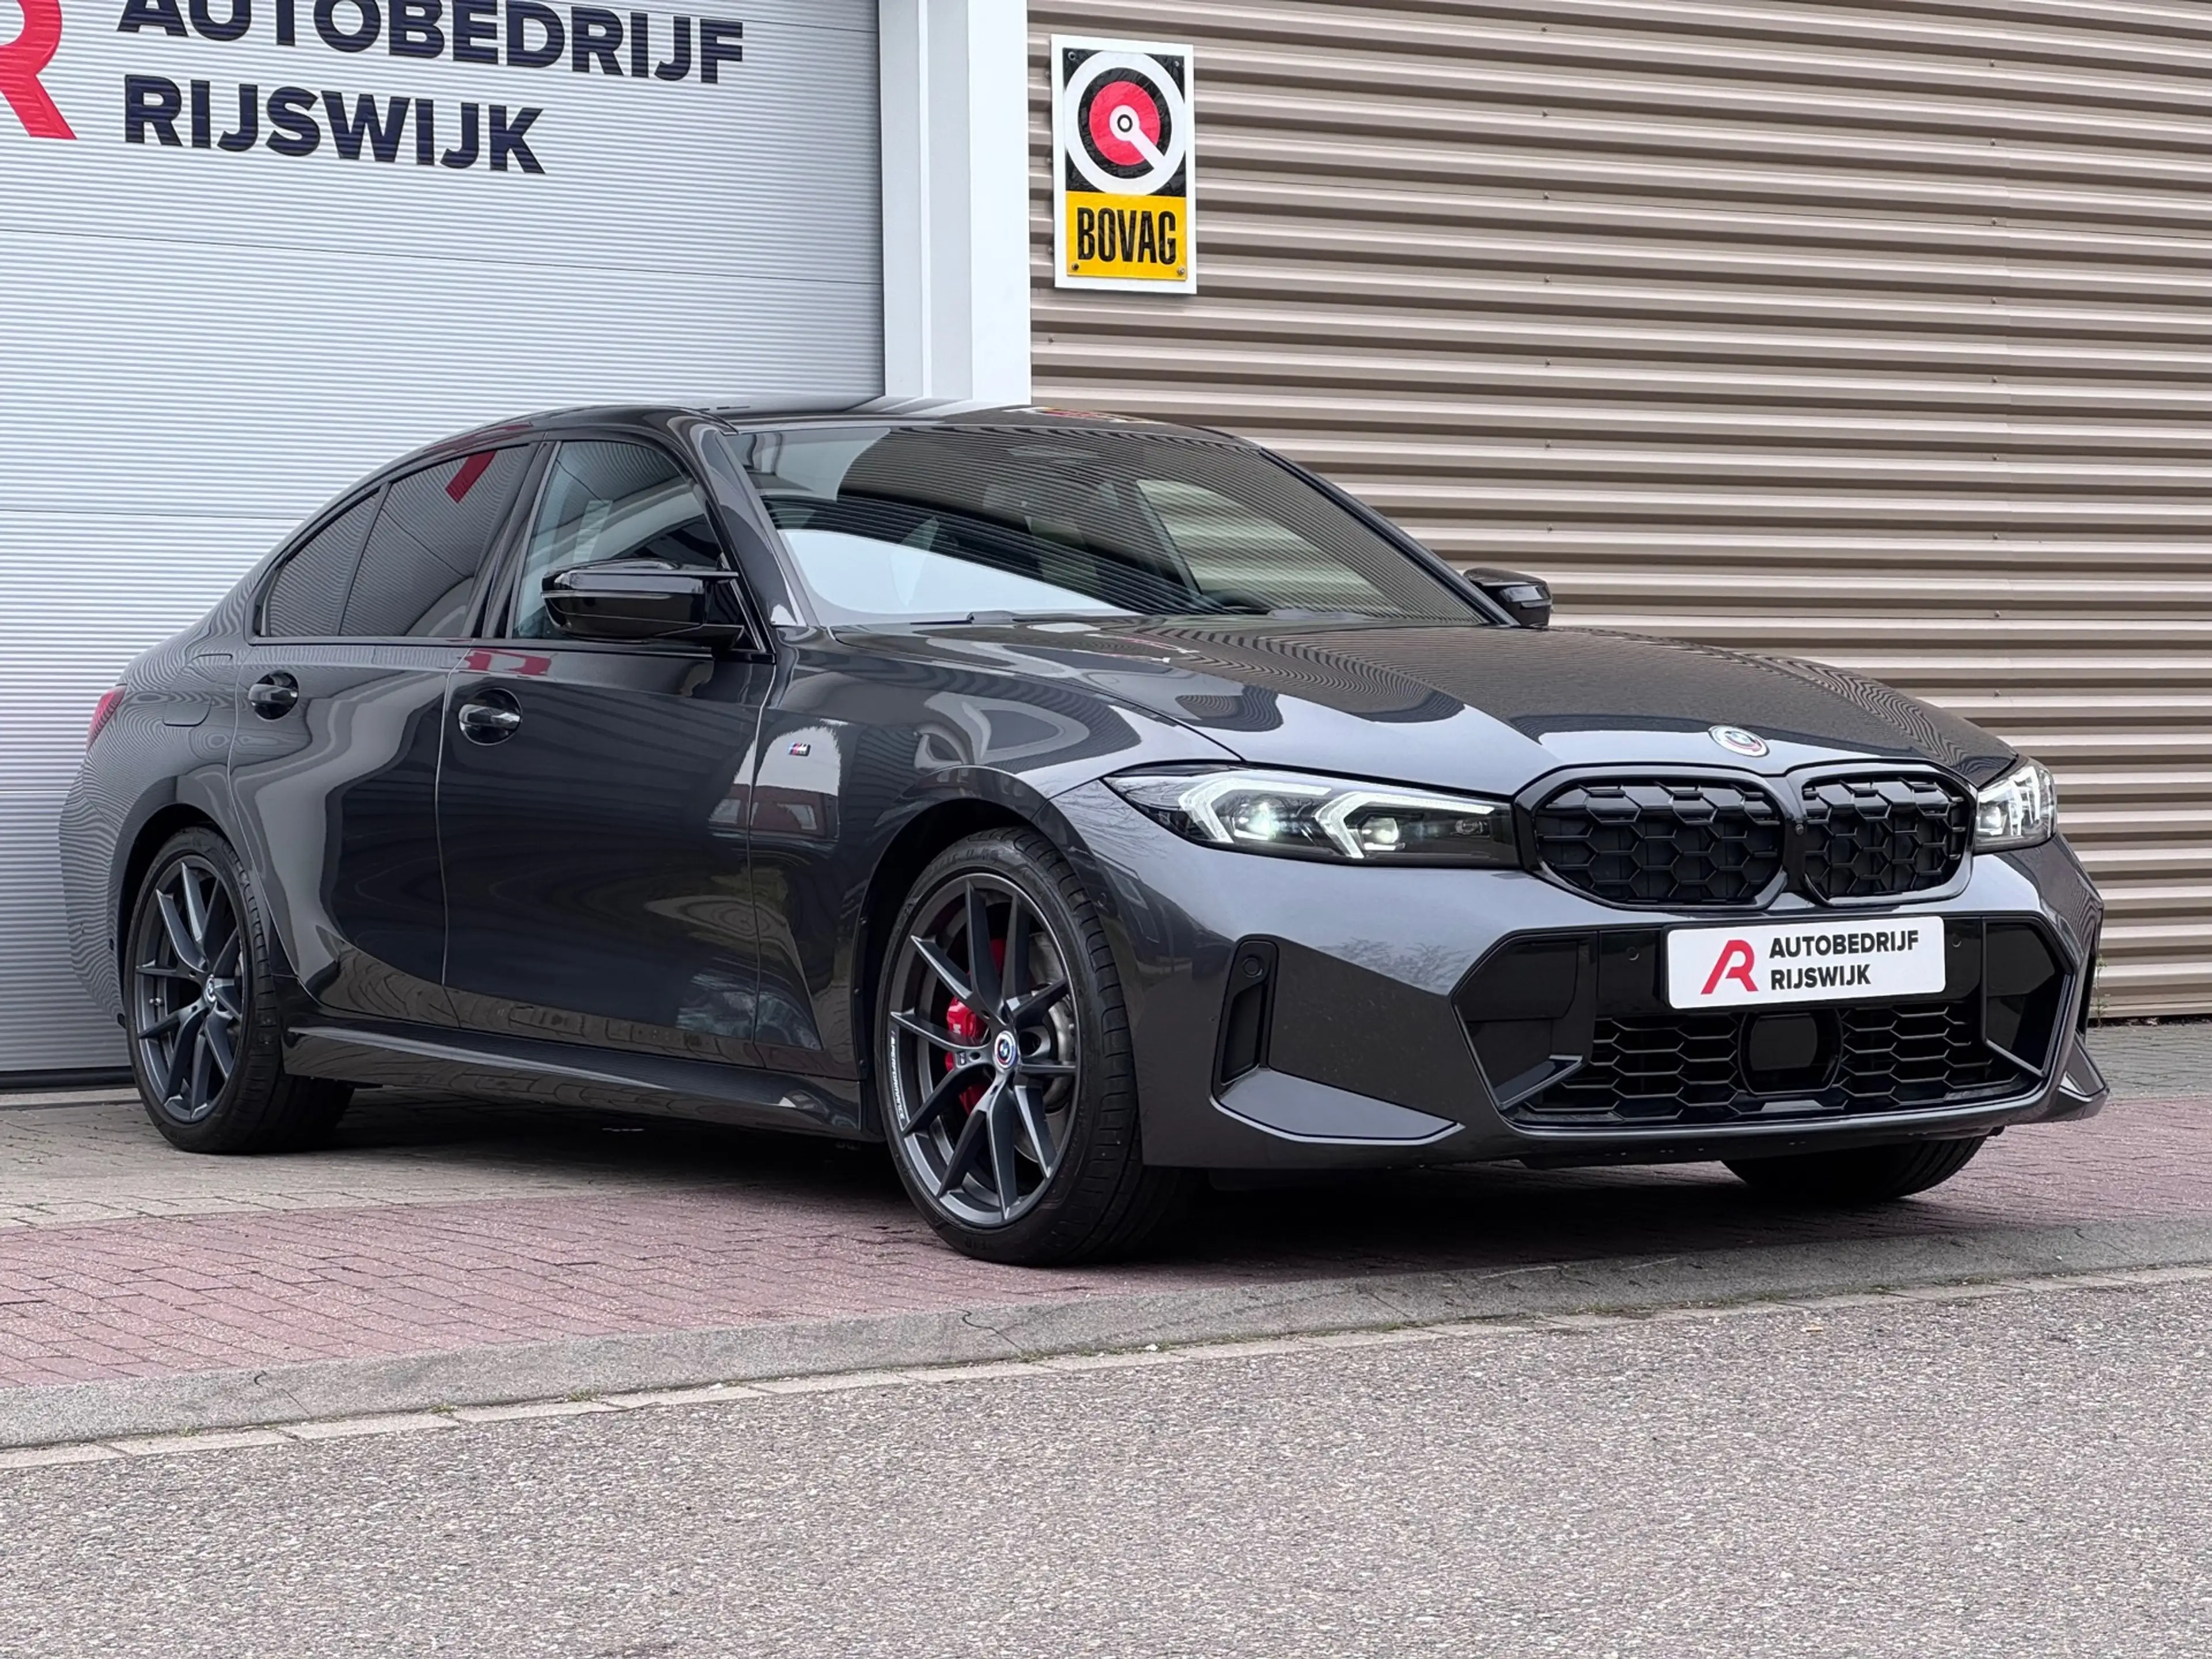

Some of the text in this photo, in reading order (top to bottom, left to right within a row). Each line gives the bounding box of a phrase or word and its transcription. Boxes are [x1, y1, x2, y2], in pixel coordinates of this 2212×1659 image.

[124, 74, 546, 175] RIJSWIJK
[1077, 207, 1176, 265] BOVAG
[1769, 930, 1919, 959] AUTOBEDRIJF
[1771, 964, 1872, 990] RIJSWIJK
